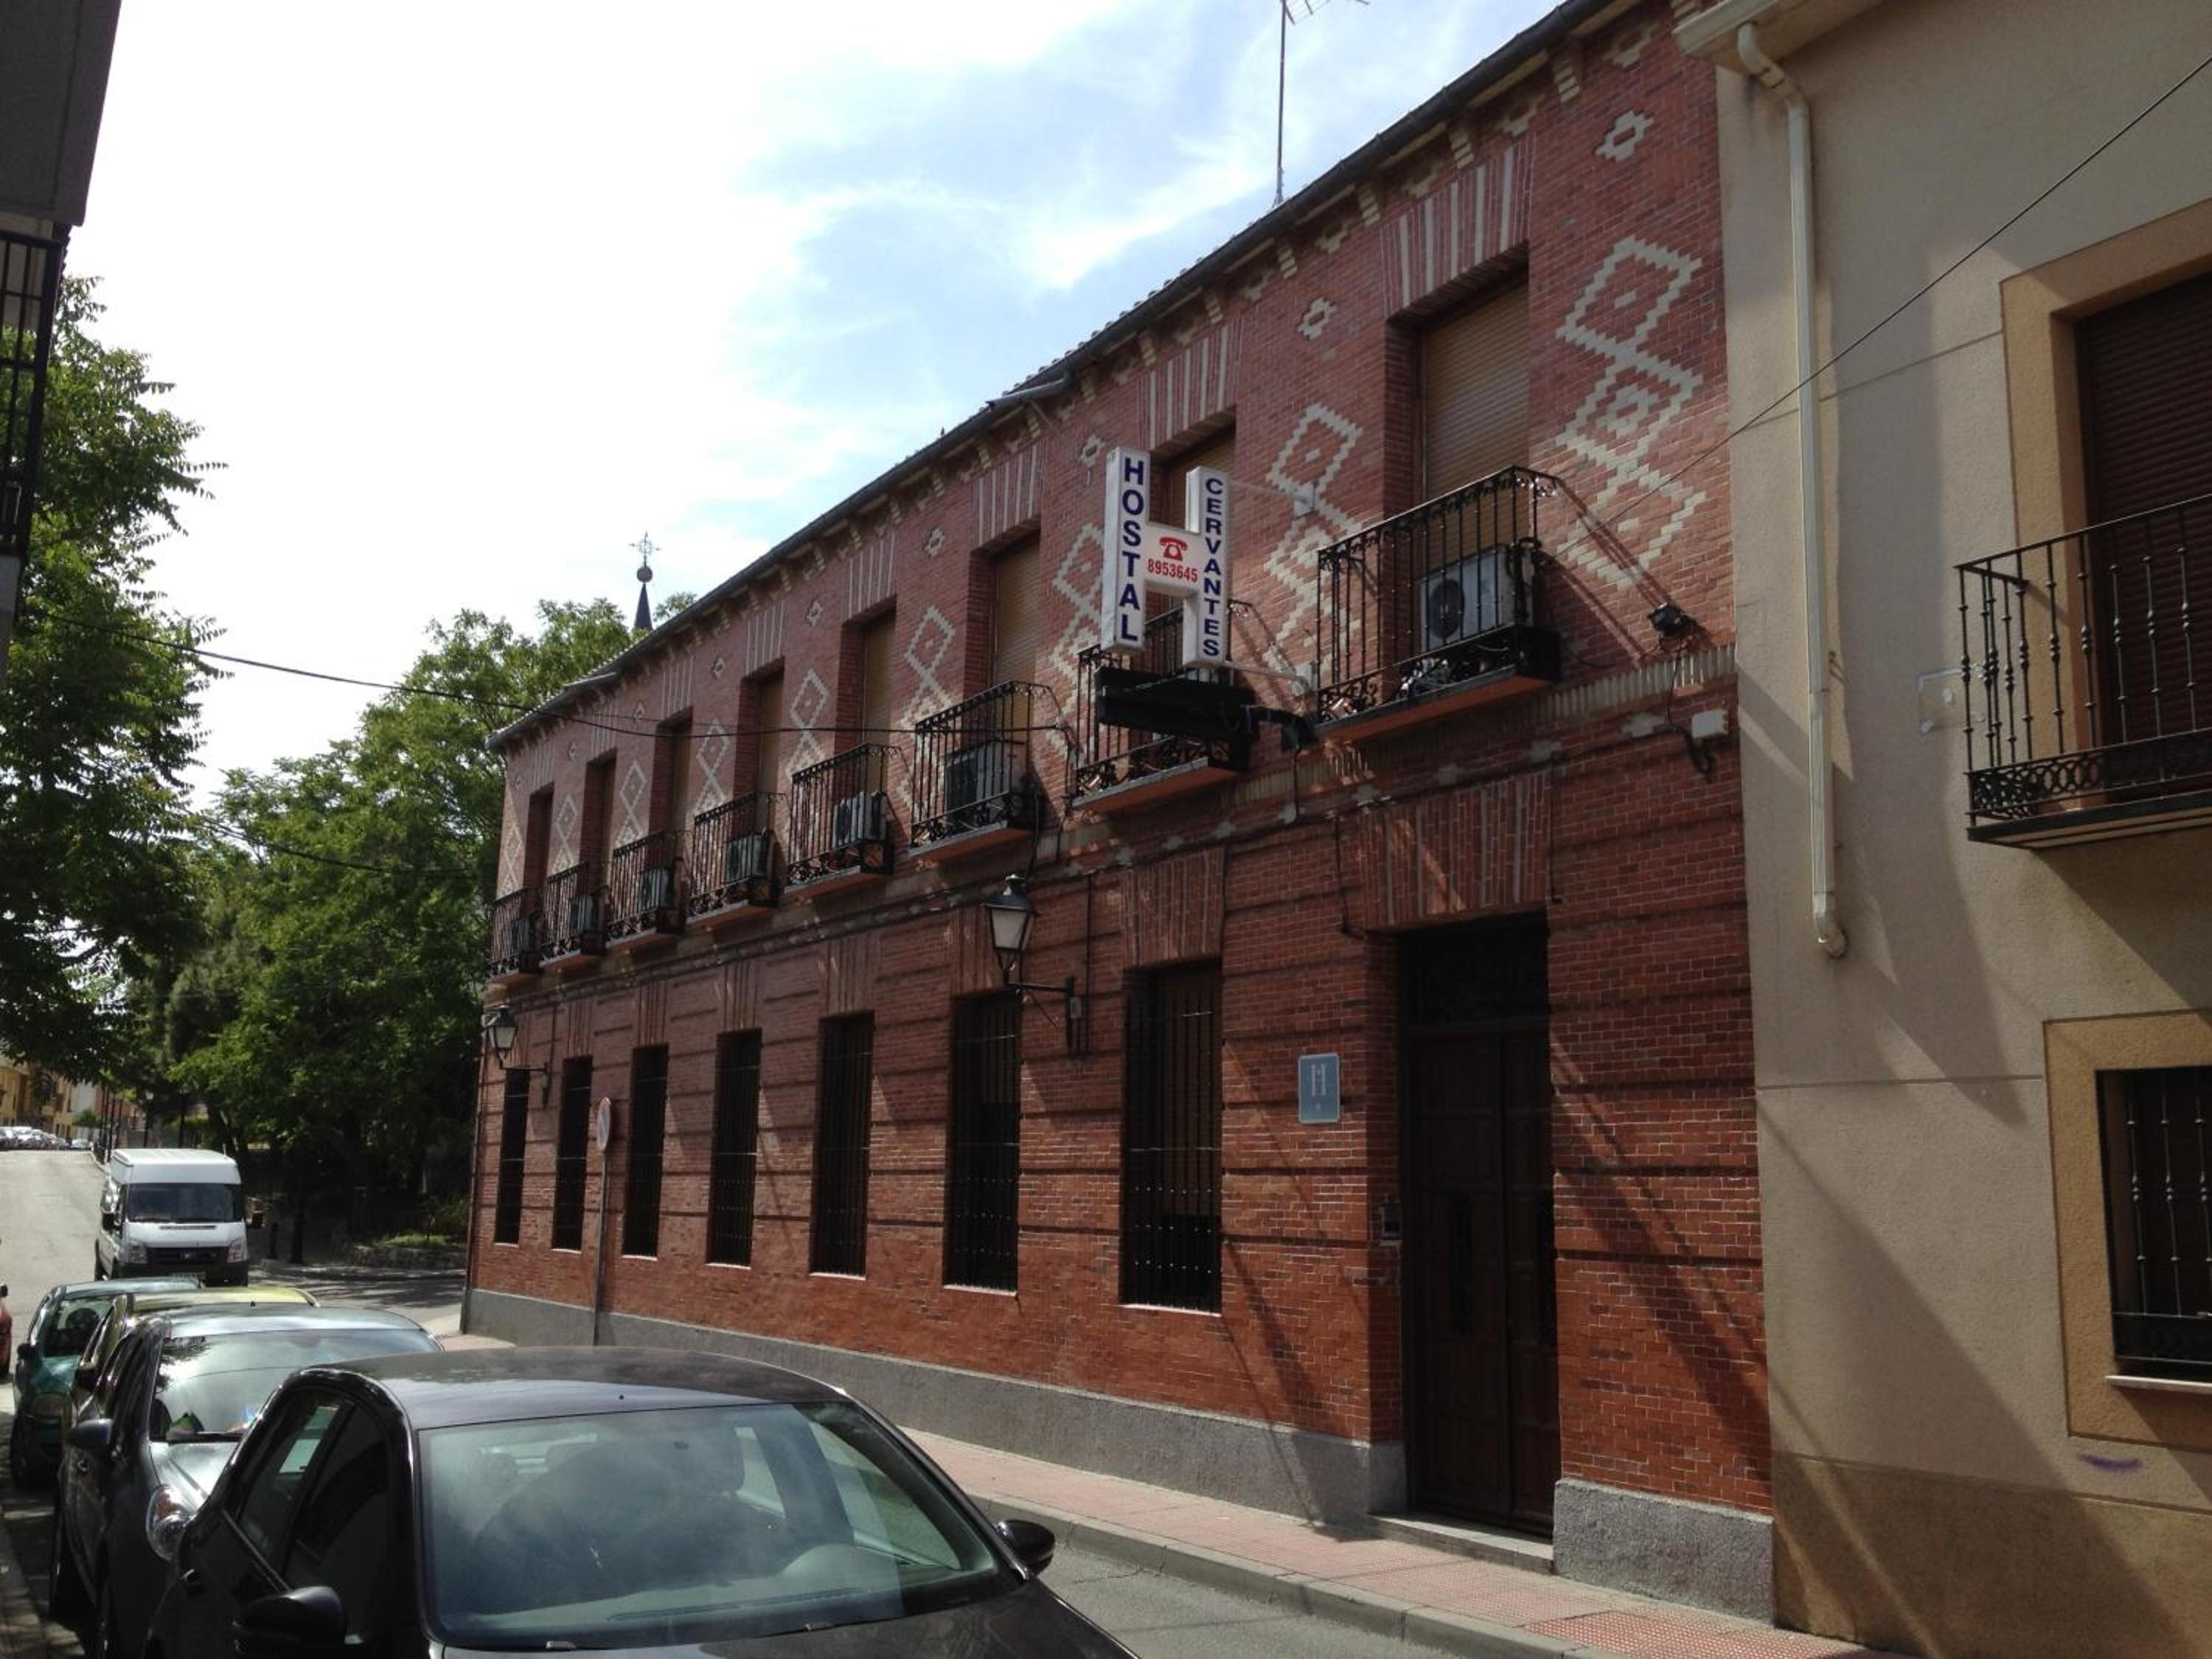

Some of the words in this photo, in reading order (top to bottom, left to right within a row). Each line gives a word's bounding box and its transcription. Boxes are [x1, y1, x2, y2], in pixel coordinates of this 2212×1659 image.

[1119, 457, 1144, 641] HOSTAL
[1148, 558, 1198, 582] 8953645
[1203, 477, 1223, 657] CERVANTES
